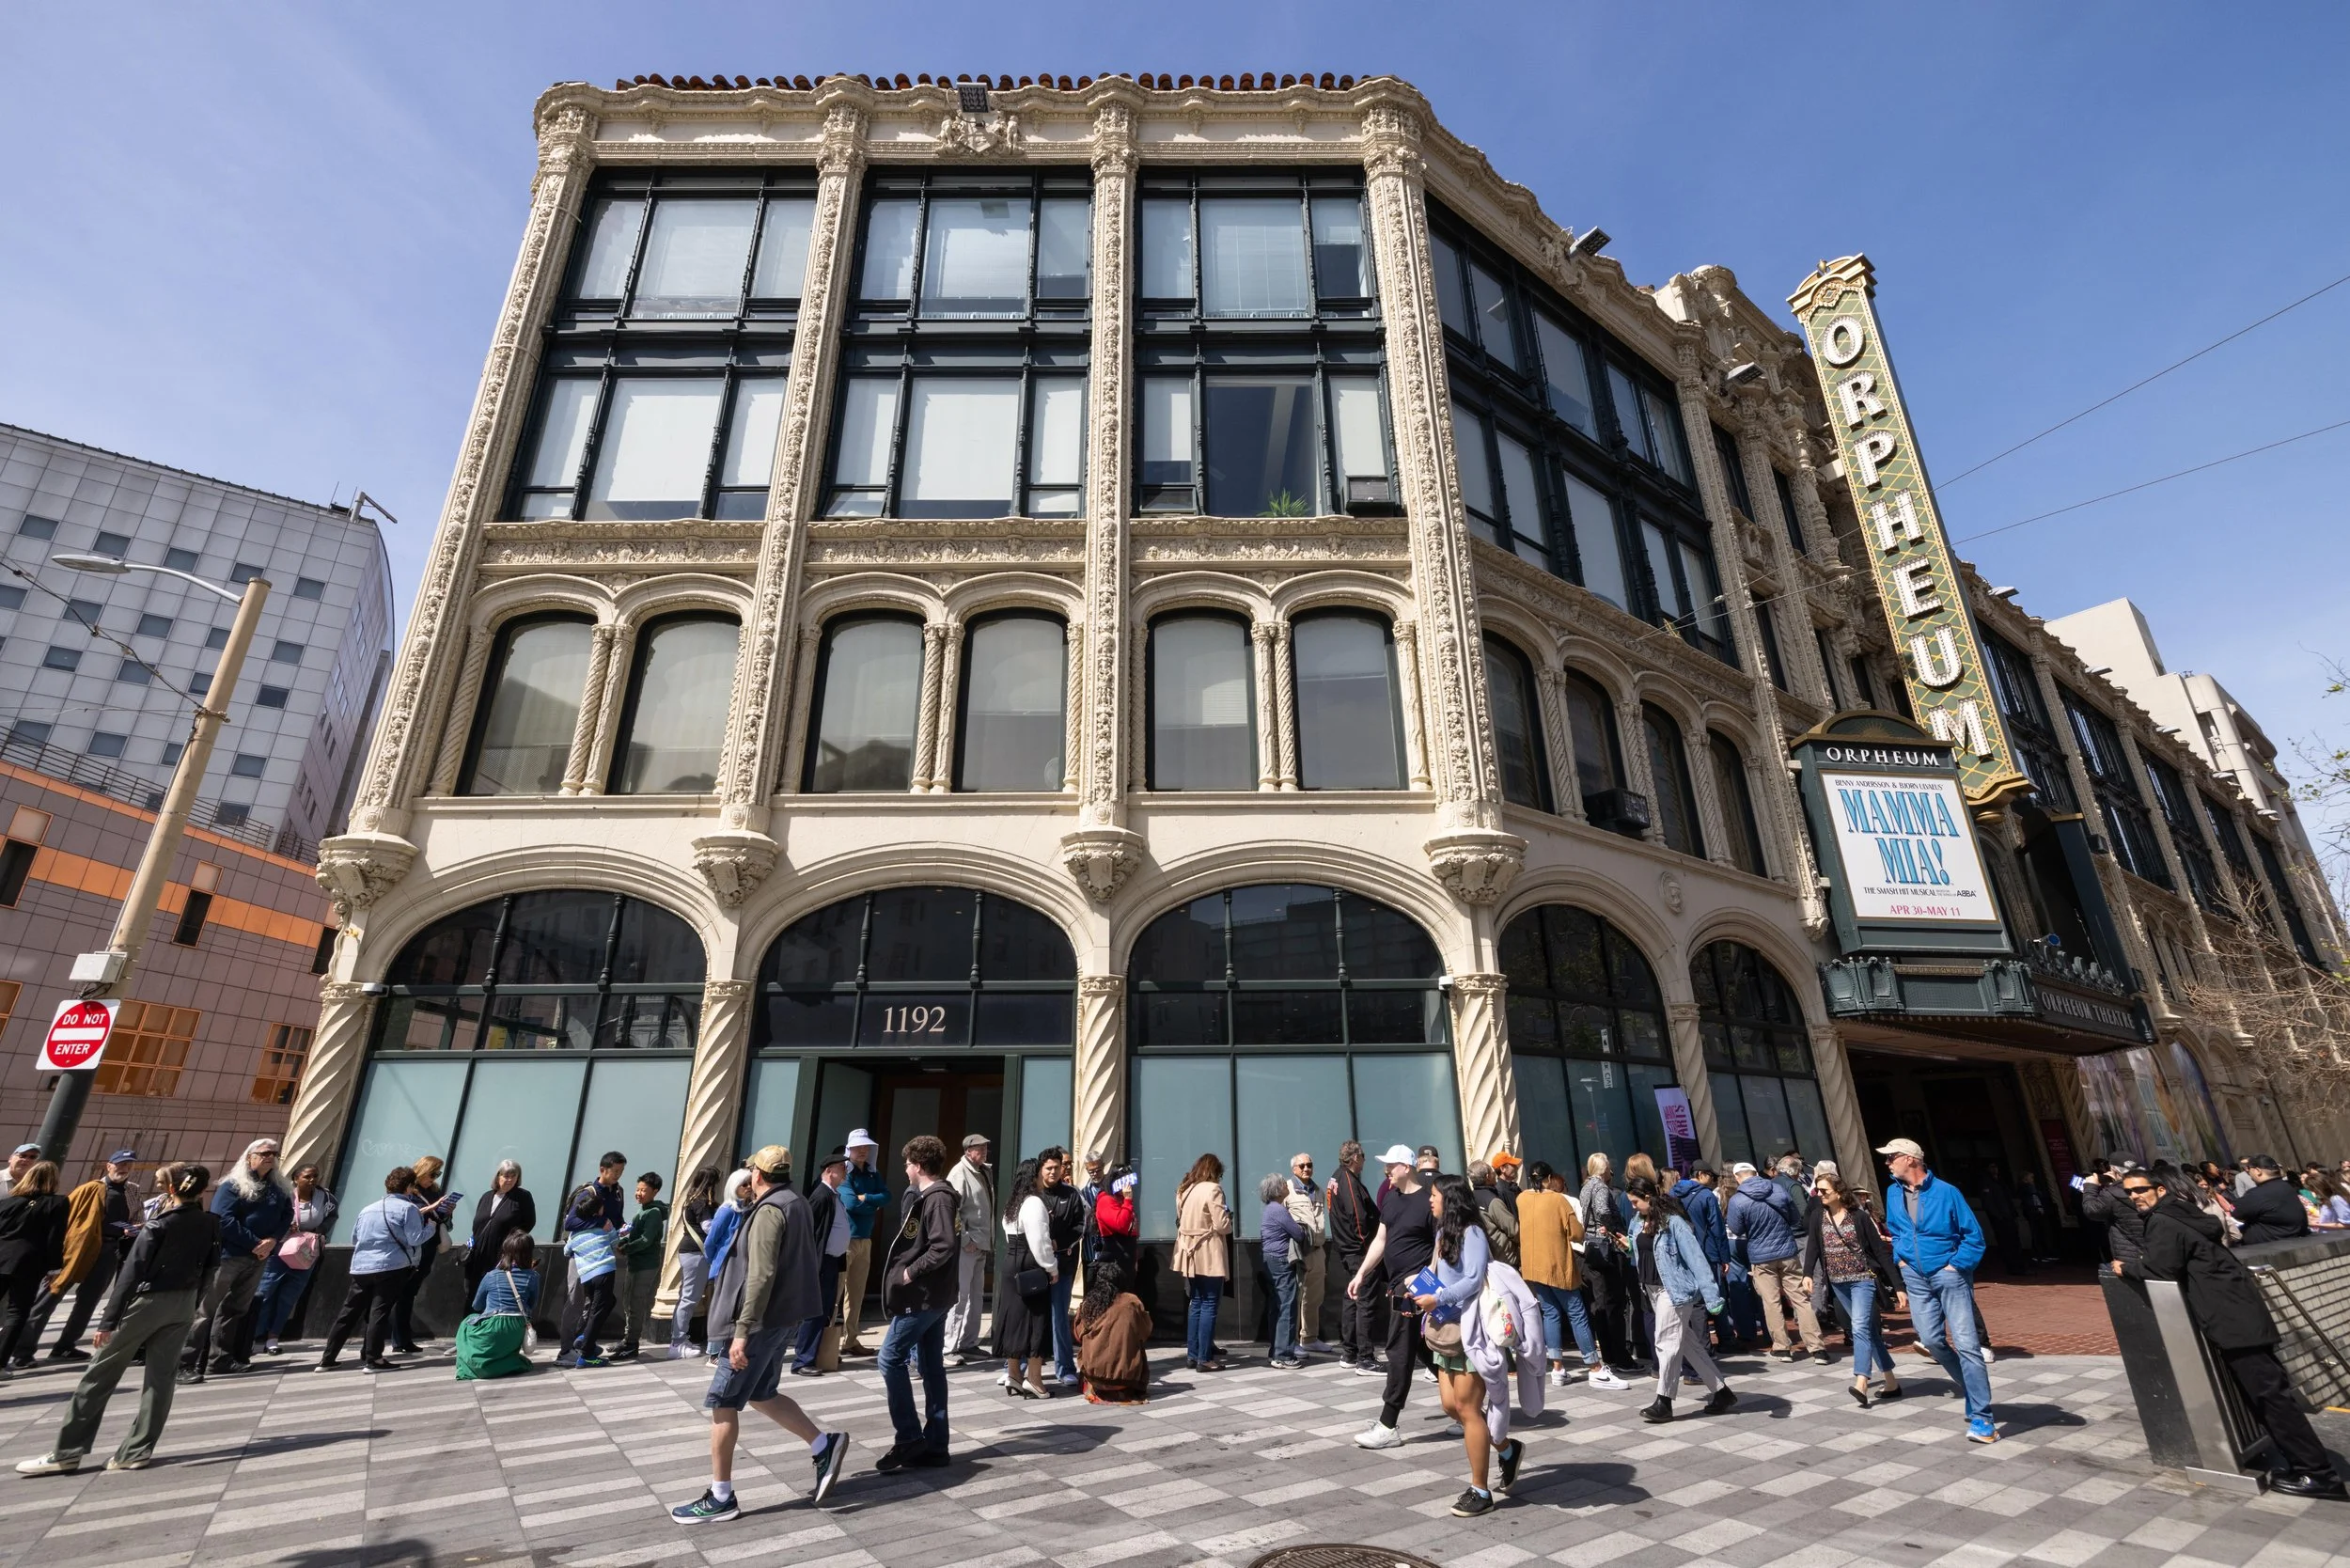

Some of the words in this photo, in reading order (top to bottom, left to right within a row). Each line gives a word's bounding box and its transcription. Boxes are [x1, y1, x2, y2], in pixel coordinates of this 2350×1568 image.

[1823, 315, 1993, 761] ORPHEUM
[1826, 747, 1940, 766] ORPHEUM
[1856, 779, 1890, 789] ANDERSSON
[1838, 789, 1961, 838] MAMMA
[1875, 838, 1950, 886] MIA!
[1863, 886, 1877, 895] THE
[1877, 887, 1900, 896] SMASH
[1910, 888, 1937, 897] MUSICAL
[1889, 904, 1910, 915] APR
[1950, 906, 1961, 917] 11
[62, 1014, 78, 1025] DO
[83, 1013, 106, 1025] NOT
[883, 1006, 947, 1033] 1192
[2041, 991, 2093, 1021] ORPHEUM
[2092, 1004, 2136, 1029] THEATRE
[55, 1043, 90, 1055] ENTER
